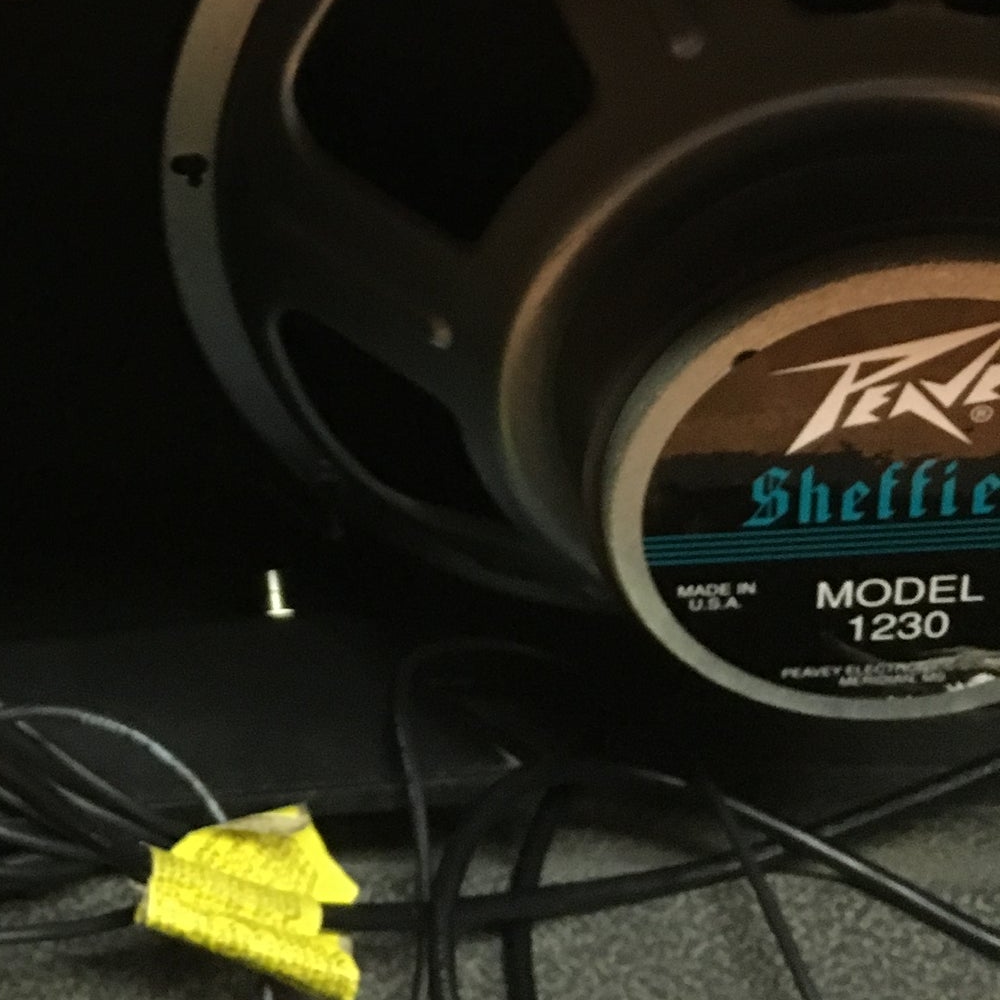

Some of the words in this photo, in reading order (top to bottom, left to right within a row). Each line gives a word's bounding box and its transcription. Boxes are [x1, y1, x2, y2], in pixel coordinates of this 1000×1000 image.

[677, 582, 731, 598] MADE
[736, 581, 758, 596] IN
[815, 573, 985, 610] MODEL
[848, 610, 950, 642] 1230
